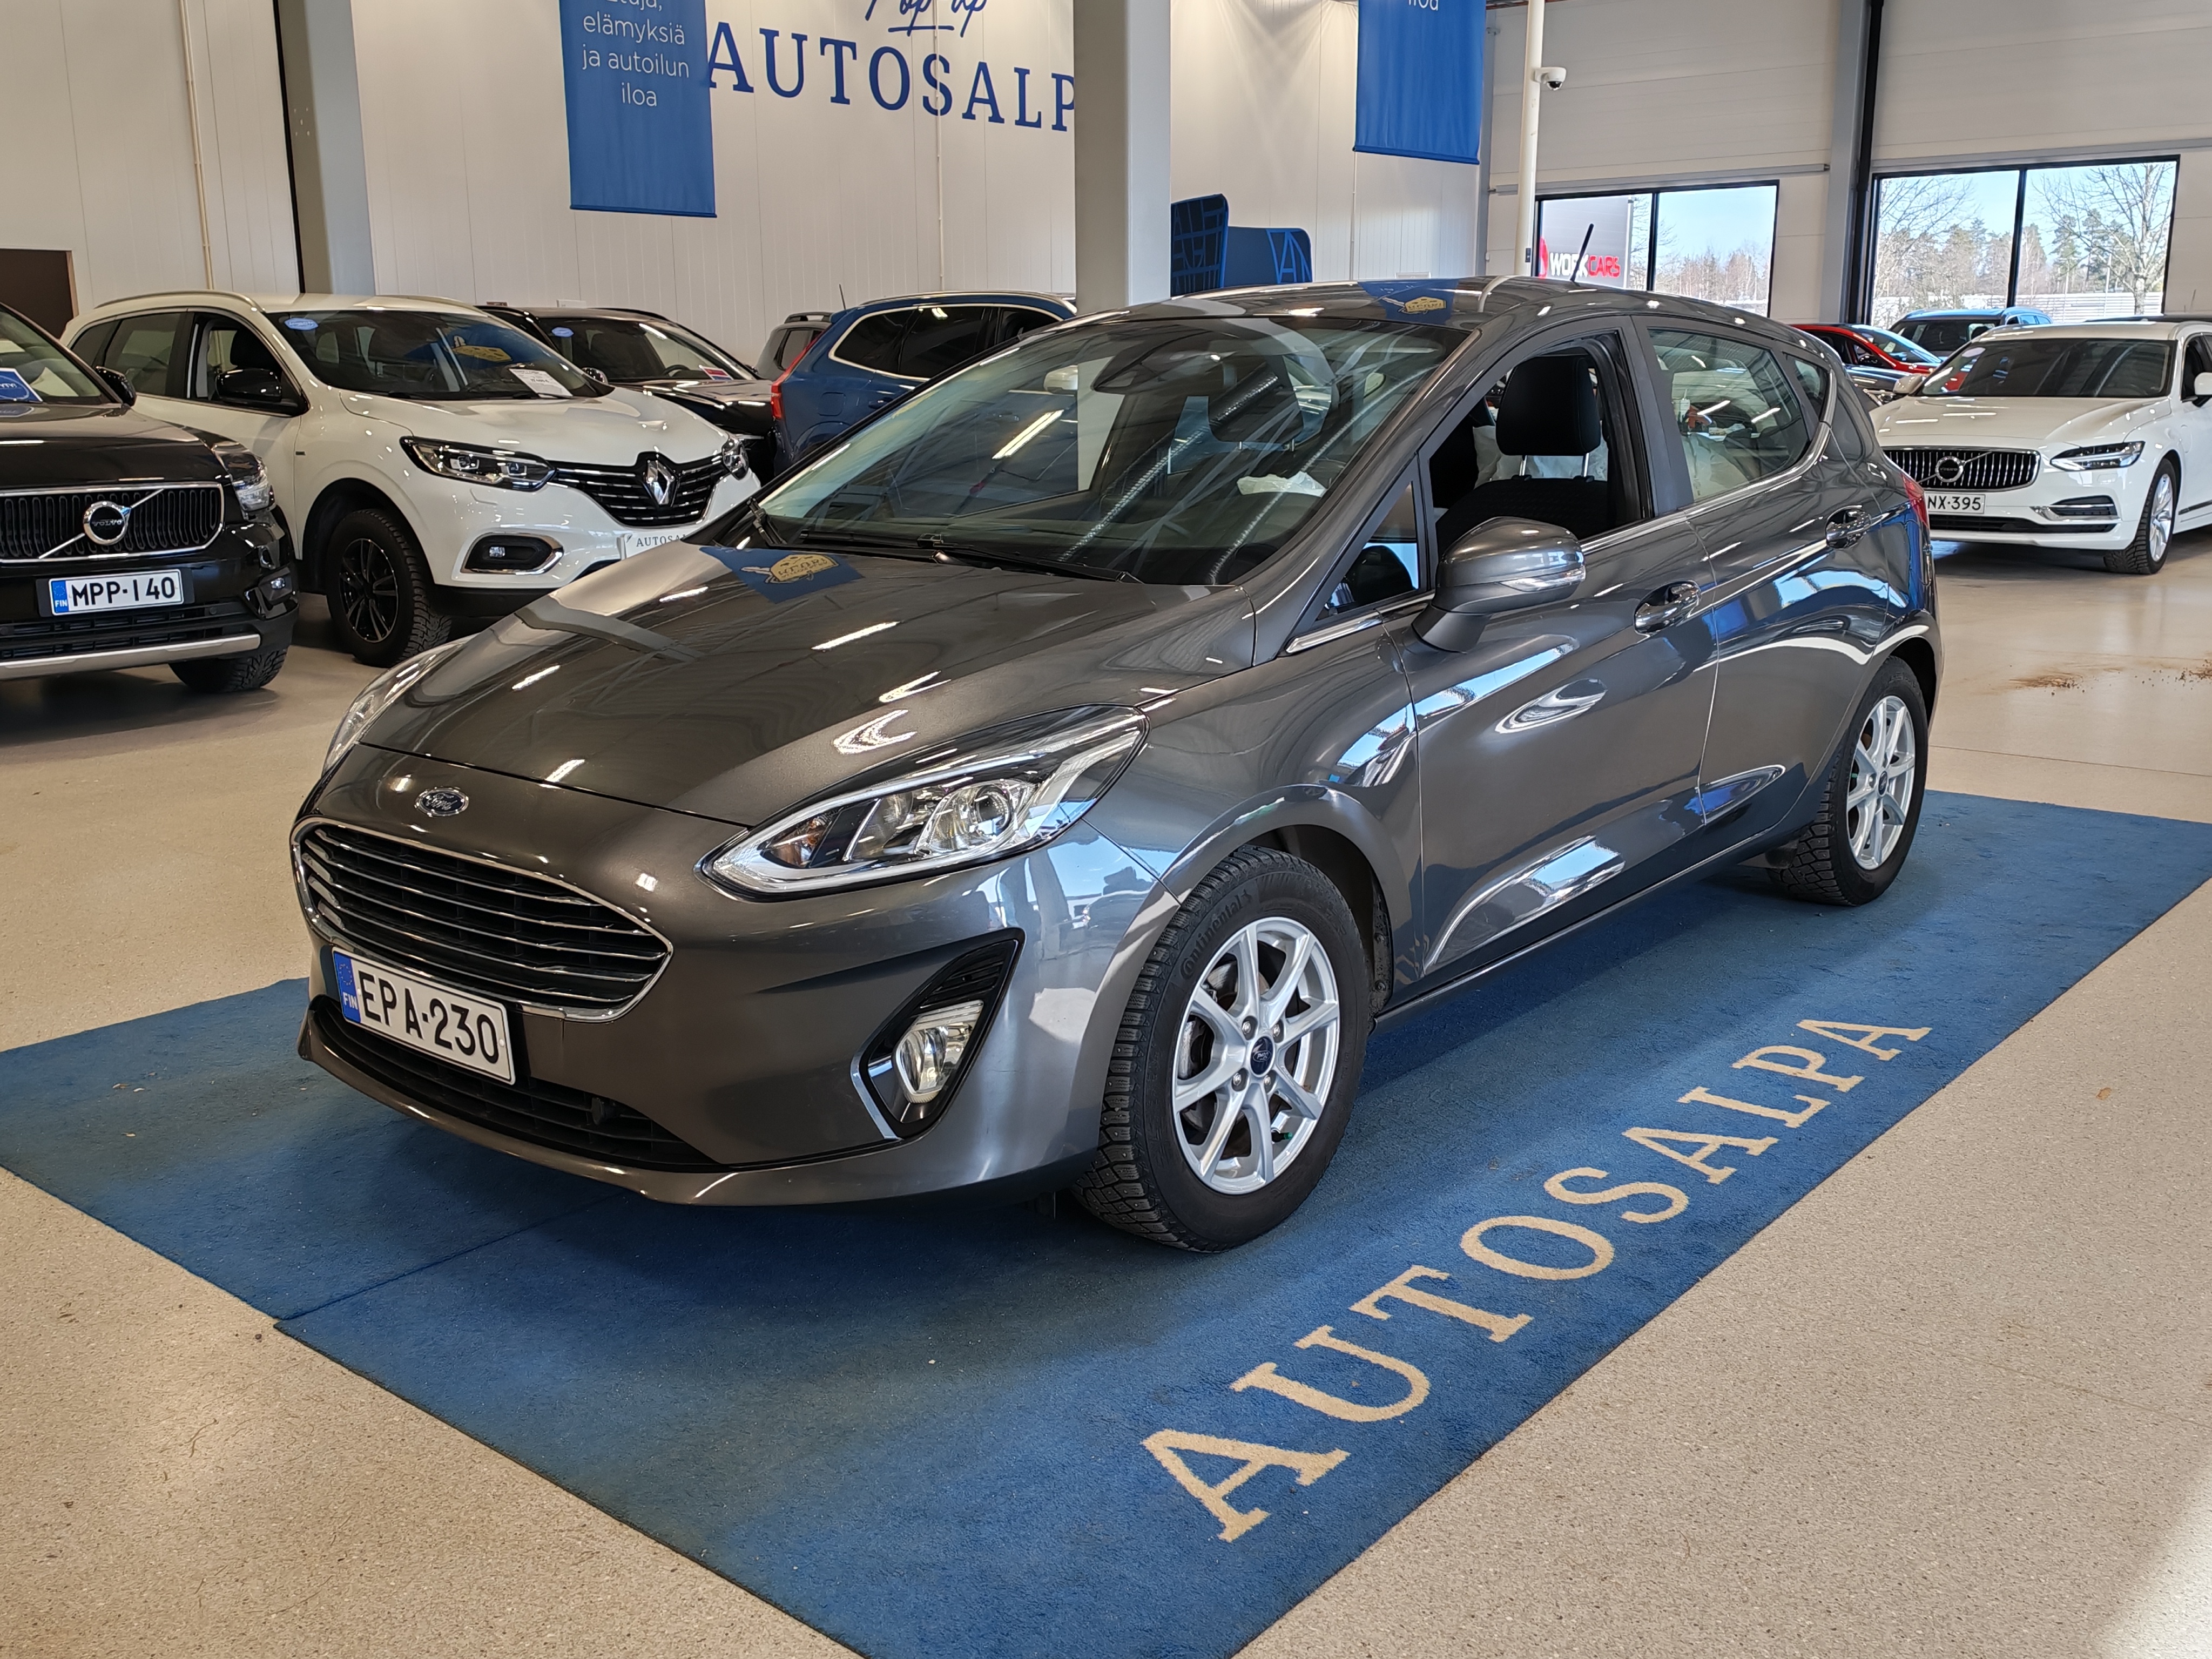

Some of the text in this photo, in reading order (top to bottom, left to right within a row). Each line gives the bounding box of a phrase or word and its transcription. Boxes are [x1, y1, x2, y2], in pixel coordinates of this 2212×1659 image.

[583, 11, 685, 45] elämyksiä
[582, 43, 689, 78] ja autoilun
[621, 82, 657, 107] iloa
[55, 599, 68, 608] FIN
[342, 992, 359, 1010] FIN
[1142, 1017, 1933, 1543] AUTOSALPA
